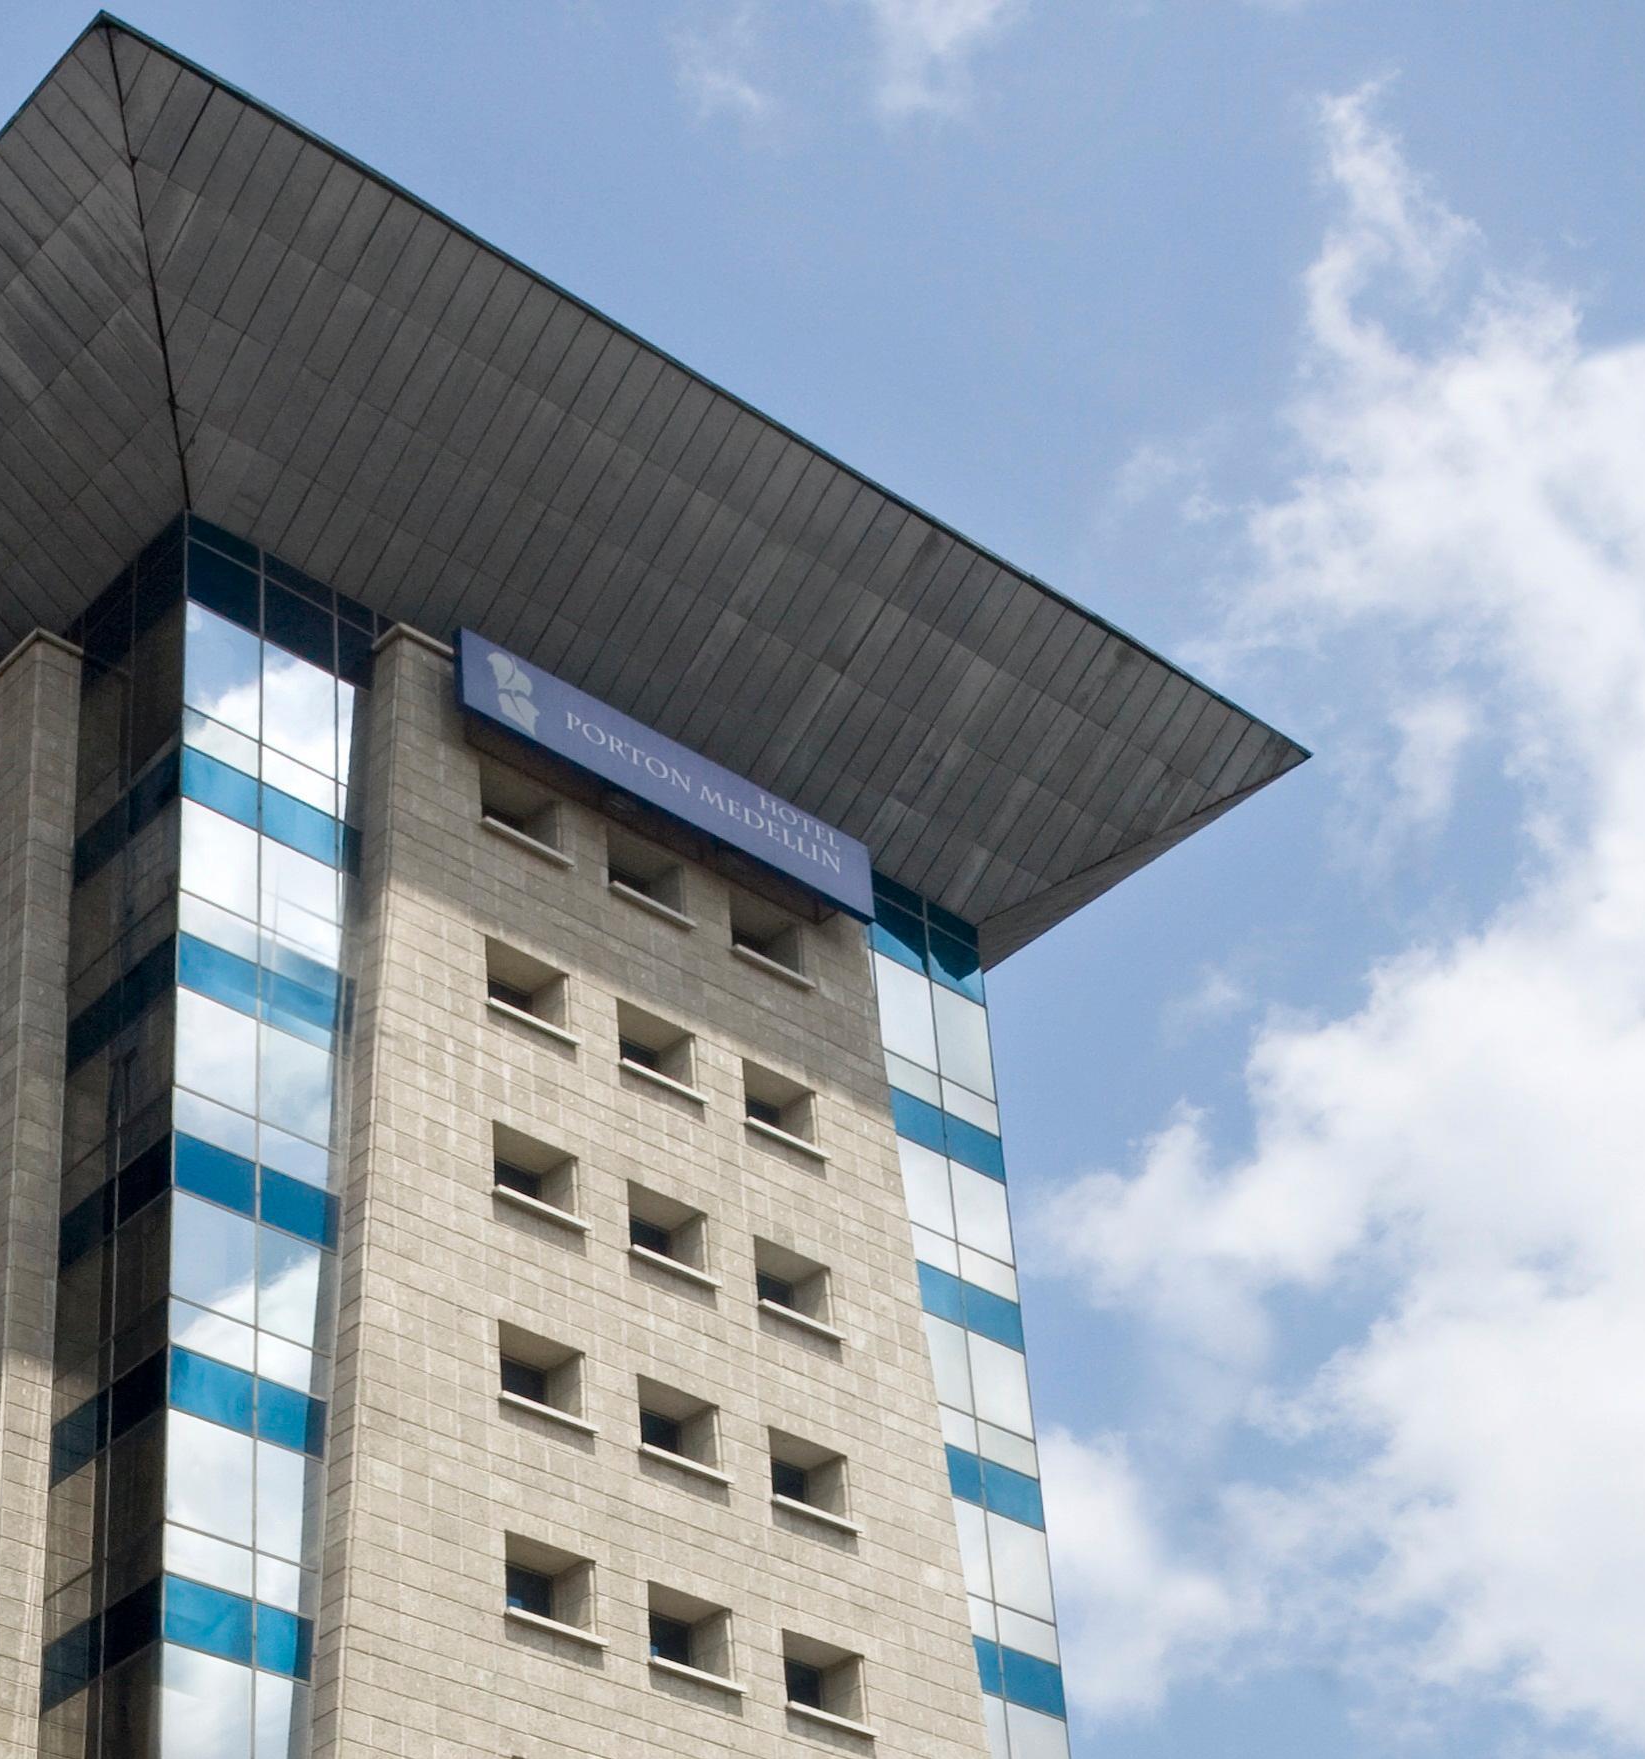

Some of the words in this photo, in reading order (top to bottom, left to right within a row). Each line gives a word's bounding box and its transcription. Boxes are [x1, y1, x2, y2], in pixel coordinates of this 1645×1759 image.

[566, 711, 690, 793] PORTON
[700, 785, 842, 876] MEDELLIN
[758, 794, 840, 850] HOTEL
